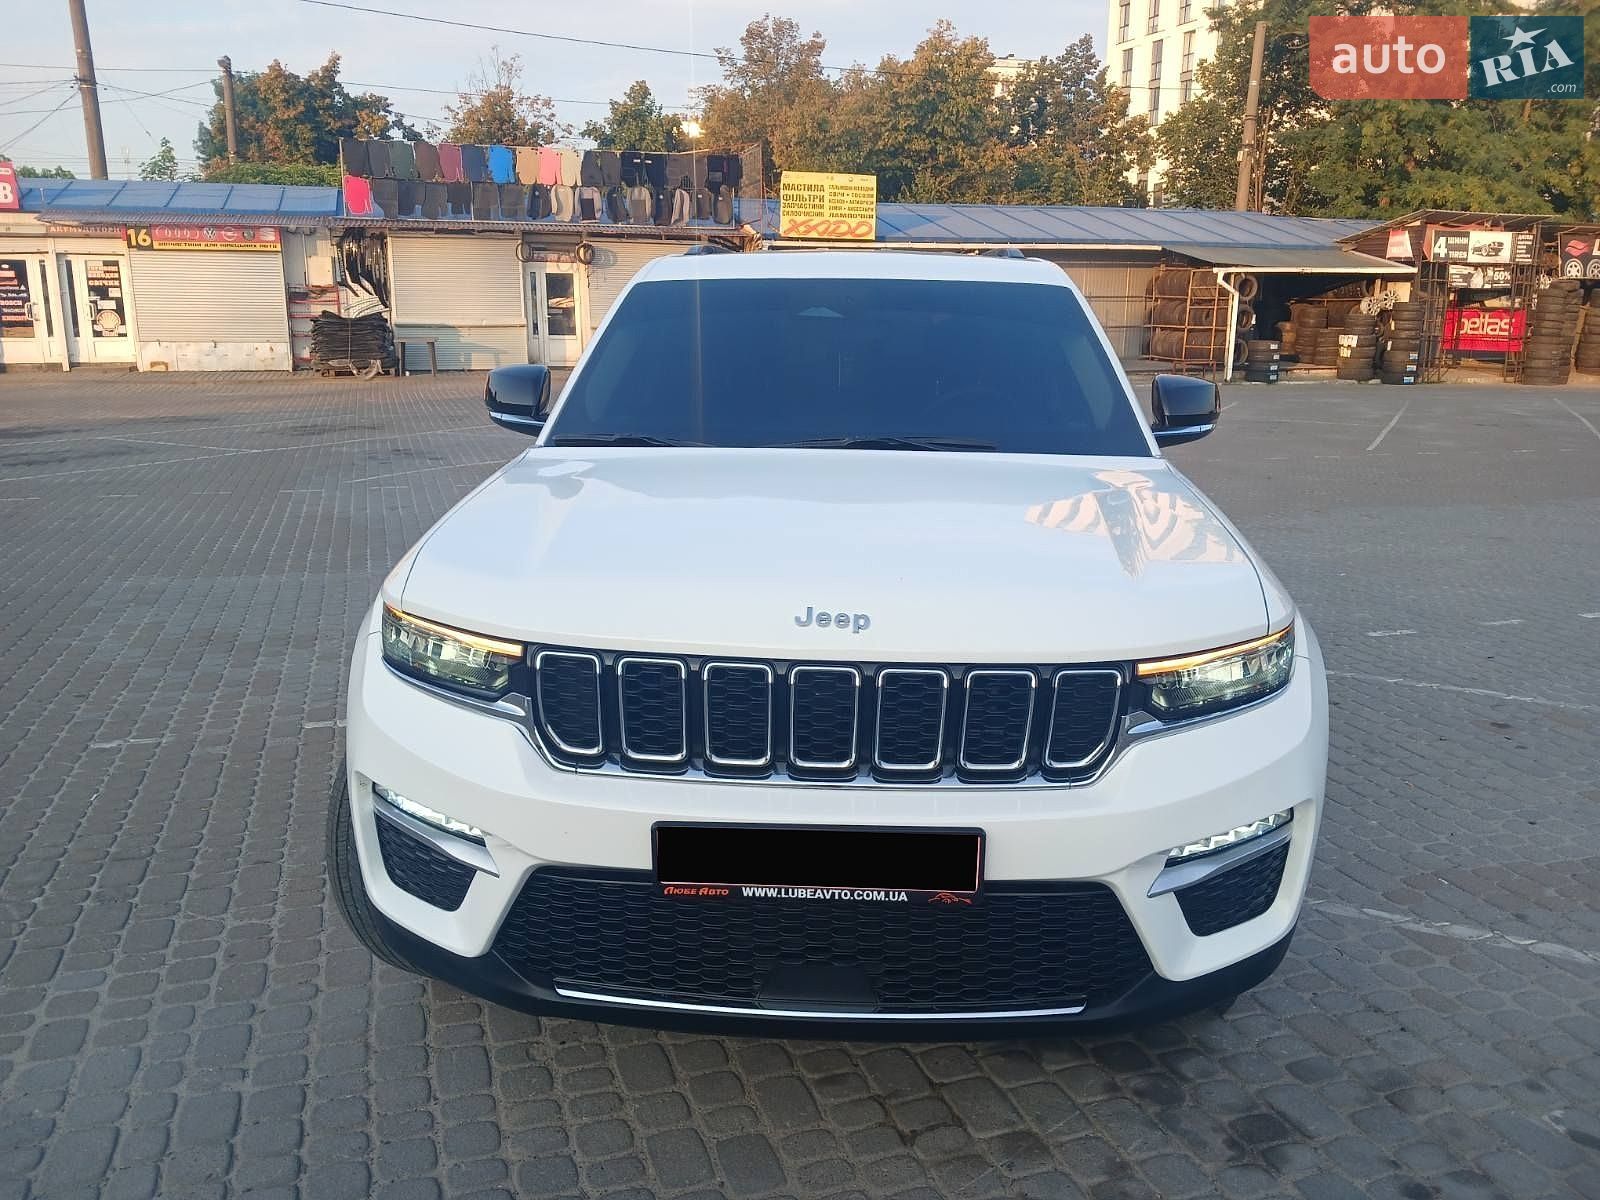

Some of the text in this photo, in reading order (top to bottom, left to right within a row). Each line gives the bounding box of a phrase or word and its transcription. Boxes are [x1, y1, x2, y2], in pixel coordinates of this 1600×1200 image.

[782, 183, 825, 193] МАСТИЛА
[782, 193, 825, 203] ФІЛЬТРИ
[127, 228, 152, 246] 16
[1434, 236, 1448, 258] 4
[794, 606, 871, 634] Jeep
[741, 886, 908, 902] WWW.LUBEAVTO.COM.UA
